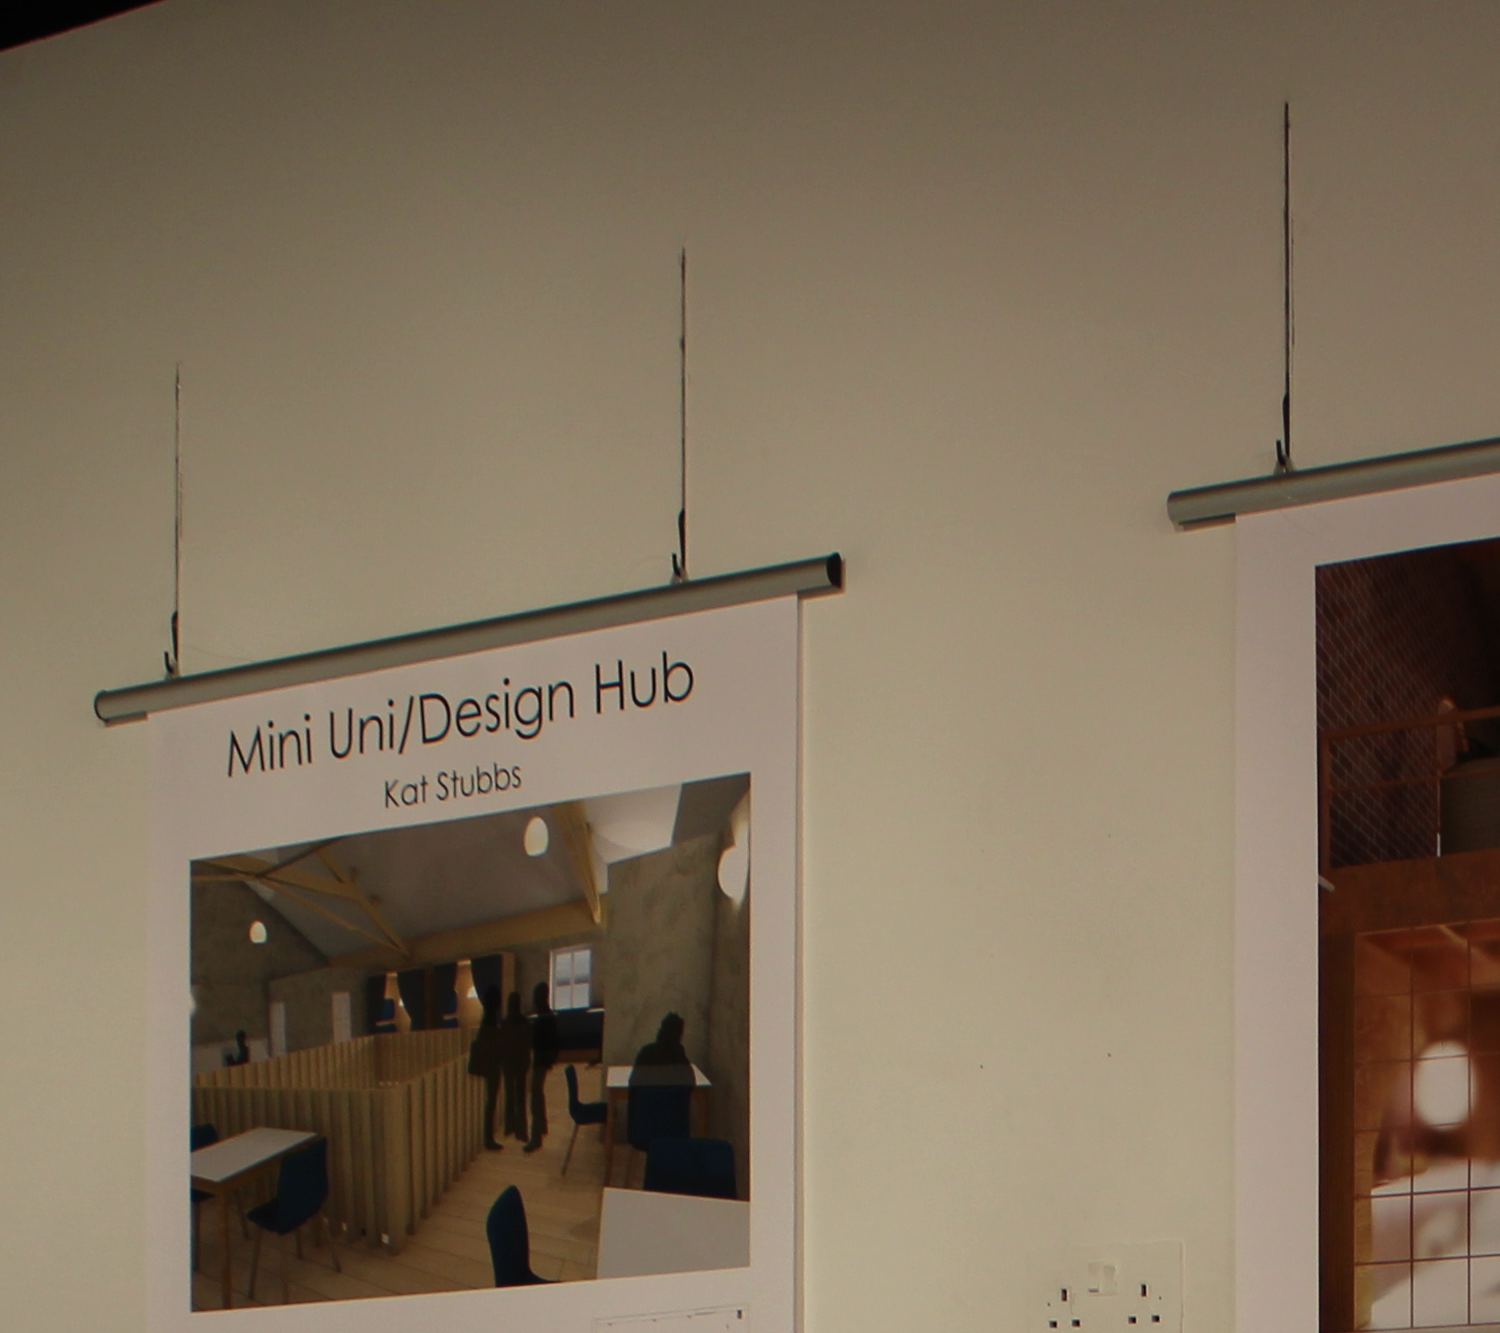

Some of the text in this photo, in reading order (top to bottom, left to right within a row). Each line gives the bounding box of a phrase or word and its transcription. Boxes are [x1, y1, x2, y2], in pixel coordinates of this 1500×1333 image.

[228, 651, 694, 777] Mini Uni/Design Hub
[384, 762, 522, 808] Kat Stubbs
